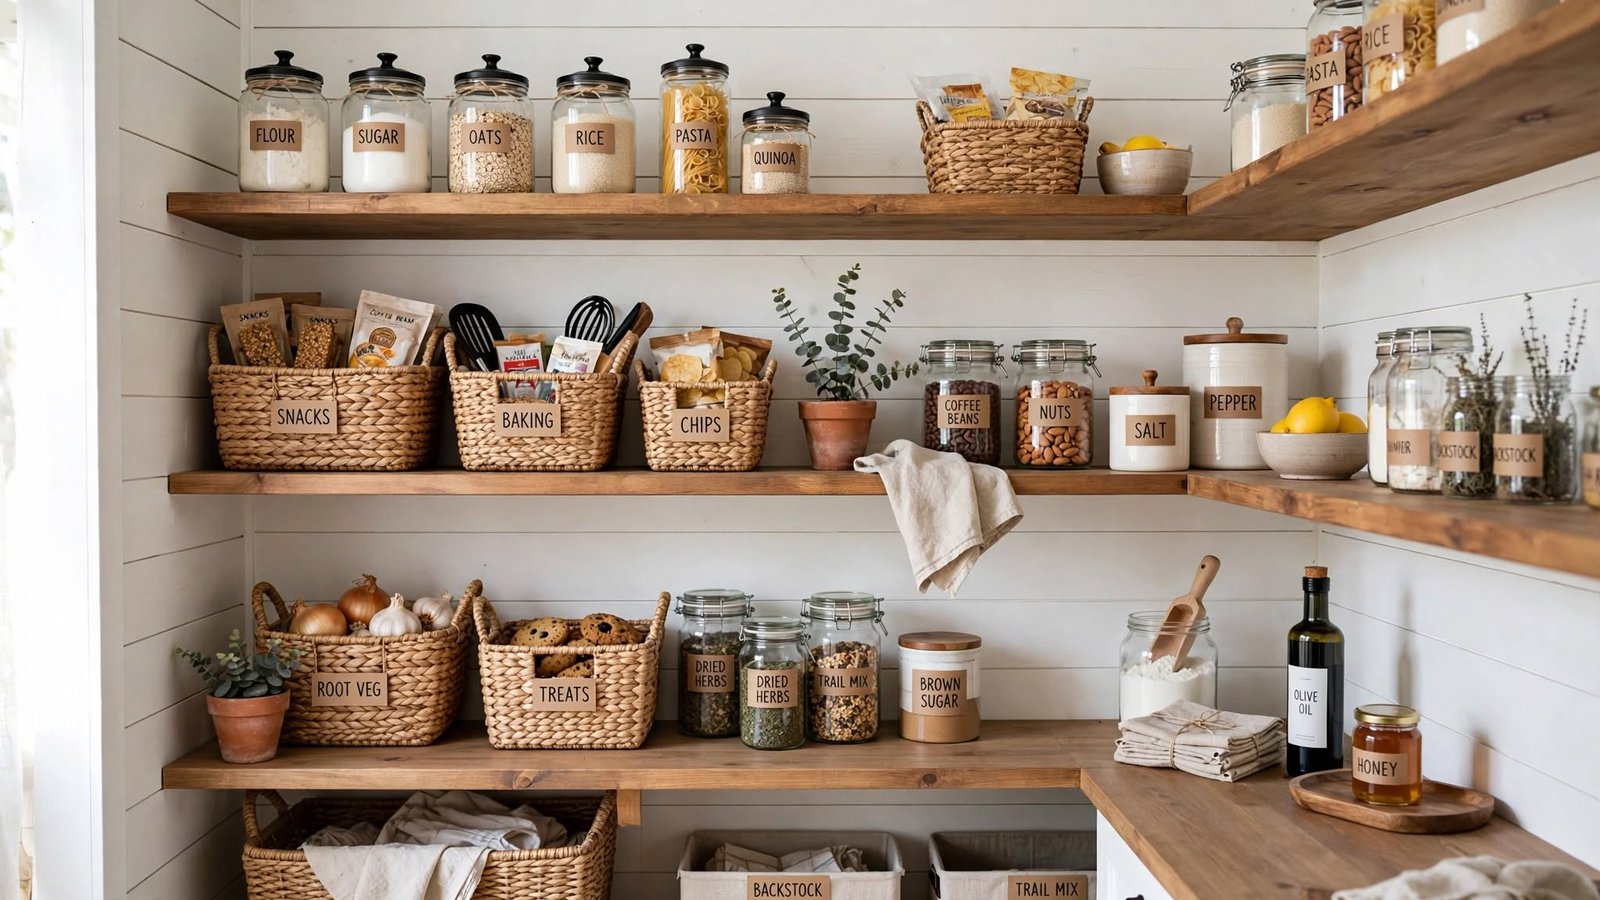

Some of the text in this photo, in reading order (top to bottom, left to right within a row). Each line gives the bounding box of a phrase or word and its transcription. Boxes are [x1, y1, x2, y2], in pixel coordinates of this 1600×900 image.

[1306, 60, 1338, 83] ASTA
[256, 127, 296, 143] FLOUR
[358, 129, 399, 145] SUGAR
[469, 129, 502, 145] OATS
[576, 130, 604, 146] RICE
[675, 128, 712, 143] PASTA
[754, 151, 796, 167] QUINOA
[944, 399, 981, 412] COFFEE
[1210, 393, 1257, 412] PEPPER
[277, 408, 330, 425] SNACKS
[502, 411, 554, 429] BAKING
[947, 412, 980, 425] BEANS
[1039, 405, 1071, 420] NUTS
[680, 416, 722, 433] CHIPS
[1134, 422, 1167, 440] SALT
[695, 660, 726, 674] DRIED
[317, 681, 382, 697] ROOT VEG
[695, 674, 727, 688] HERBS
[756, 675, 789, 689] DRIED
[818, 674, 869, 689] TRAIL MIX
[920, 677, 961, 692] BROWN
[539, 686, 590, 703] TREATS
[756, 690, 790, 704] HERBS
[920, 693, 959, 709] SUGAR
[1293, 689, 1319, 703] OLIVE
[1298, 703, 1313, 716] OIL
[1357, 757, 1398, 777] HONEY
[753, 882, 823, 898] BACKSTOCK
[1016, 882, 1079, 897] TRAIL MIX
